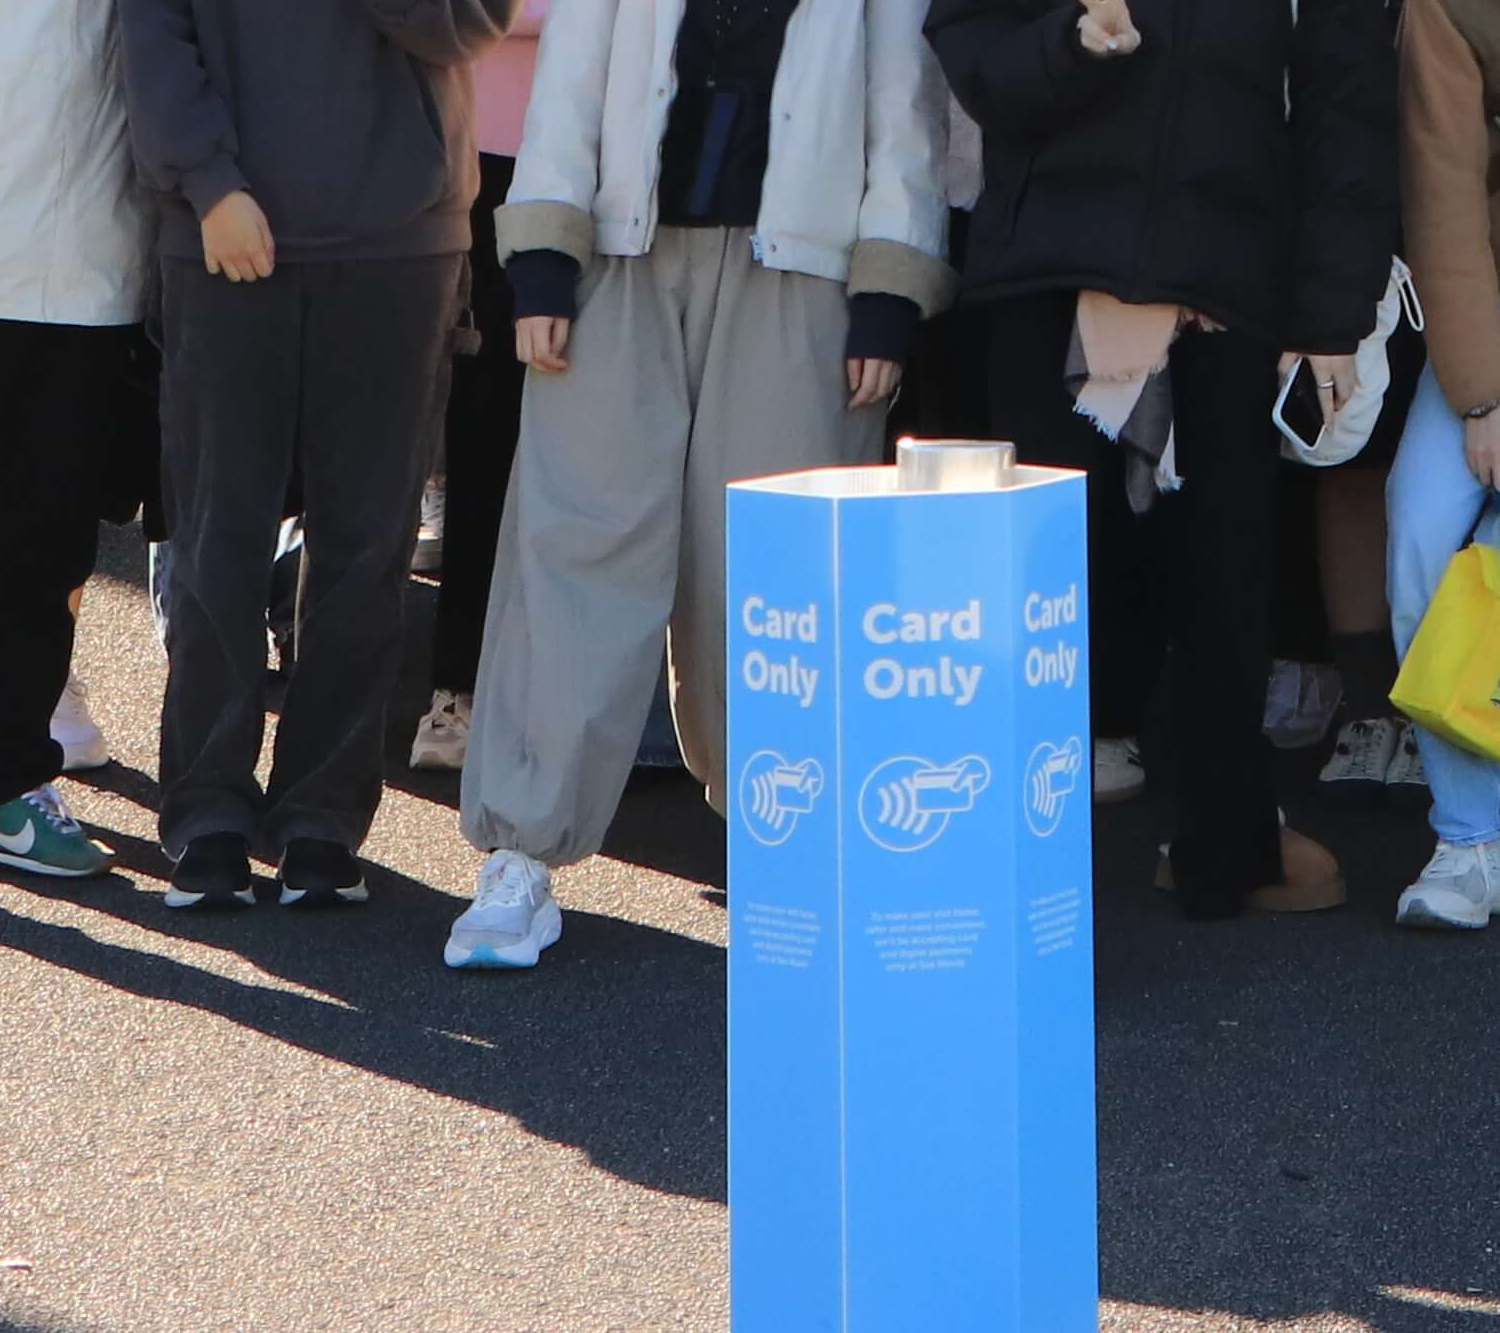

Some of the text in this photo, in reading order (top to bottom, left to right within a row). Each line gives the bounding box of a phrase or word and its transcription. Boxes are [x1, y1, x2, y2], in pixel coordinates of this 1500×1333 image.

[743, 596, 818, 644] Card
[862, 599, 982, 644] Card
[1024, 583, 1077, 633] Card
[743, 650, 819, 708] Only
[863, 656, 983, 706] Only
[1025, 641, 1078, 688] Only
